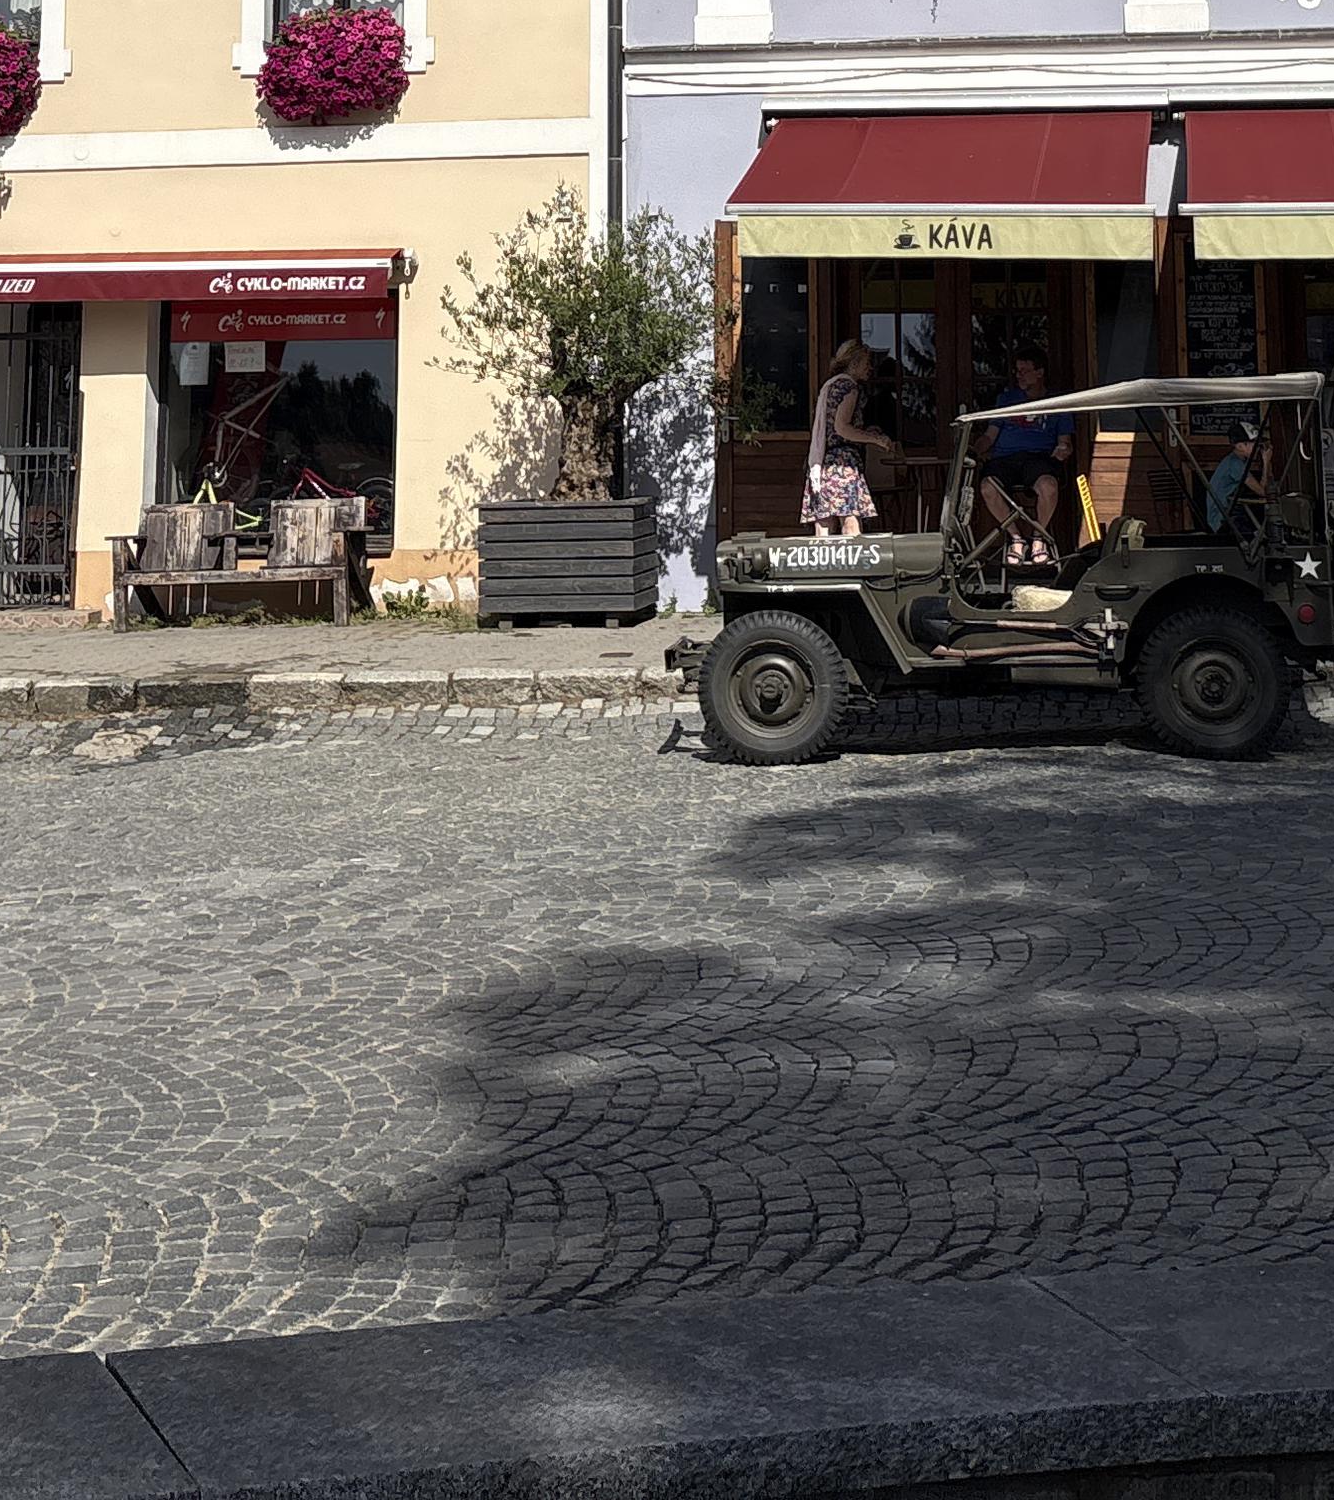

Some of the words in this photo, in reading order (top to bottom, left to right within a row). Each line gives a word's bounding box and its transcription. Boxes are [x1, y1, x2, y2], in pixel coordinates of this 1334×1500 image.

[929, 216, 993, 250] KÁVA
[236, 276, 366, 292] CYKLO-MARKET.CZ
[247, 314, 347, 326] CYKLO-MARKET.CZ
[768, 544, 881, 568] W-20301417-S
